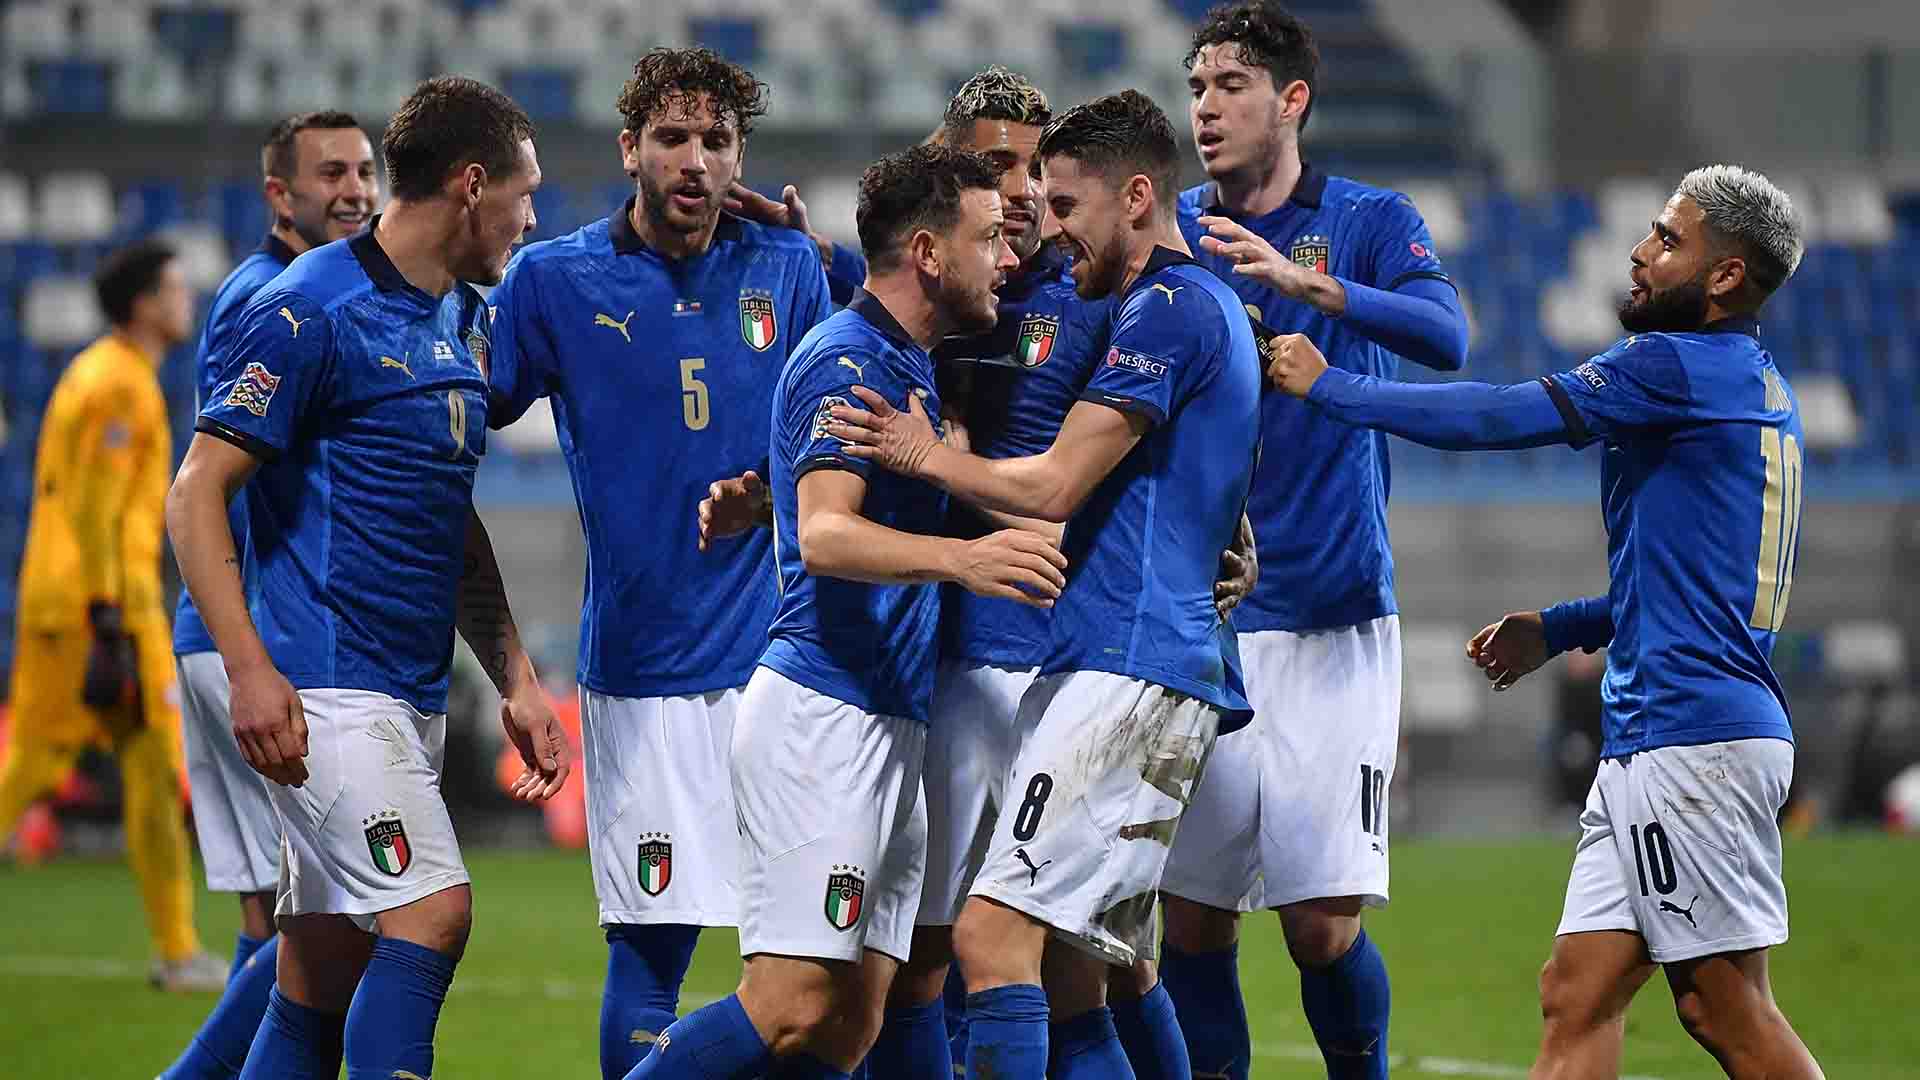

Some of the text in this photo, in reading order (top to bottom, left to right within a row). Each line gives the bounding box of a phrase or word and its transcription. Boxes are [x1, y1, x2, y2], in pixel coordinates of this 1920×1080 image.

[1295, 247, 1327, 257] ITALIA
[742, 301, 771, 310] ITALIA
[1024, 323, 1055, 333] ITALIA
[1118, 354, 1168, 375] RESPECT
[680, 358, 709, 431] 5
[448, 389, 466, 455] 9
[1754, 426, 1803, 633] 10
[1013, 772, 1053, 843] 8
[368, 823, 400, 840] ITALIA
[640, 845, 669, 855] ITALIA
[1630, 822, 1678, 896] 10
[832, 877, 862, 890] ITALIA
